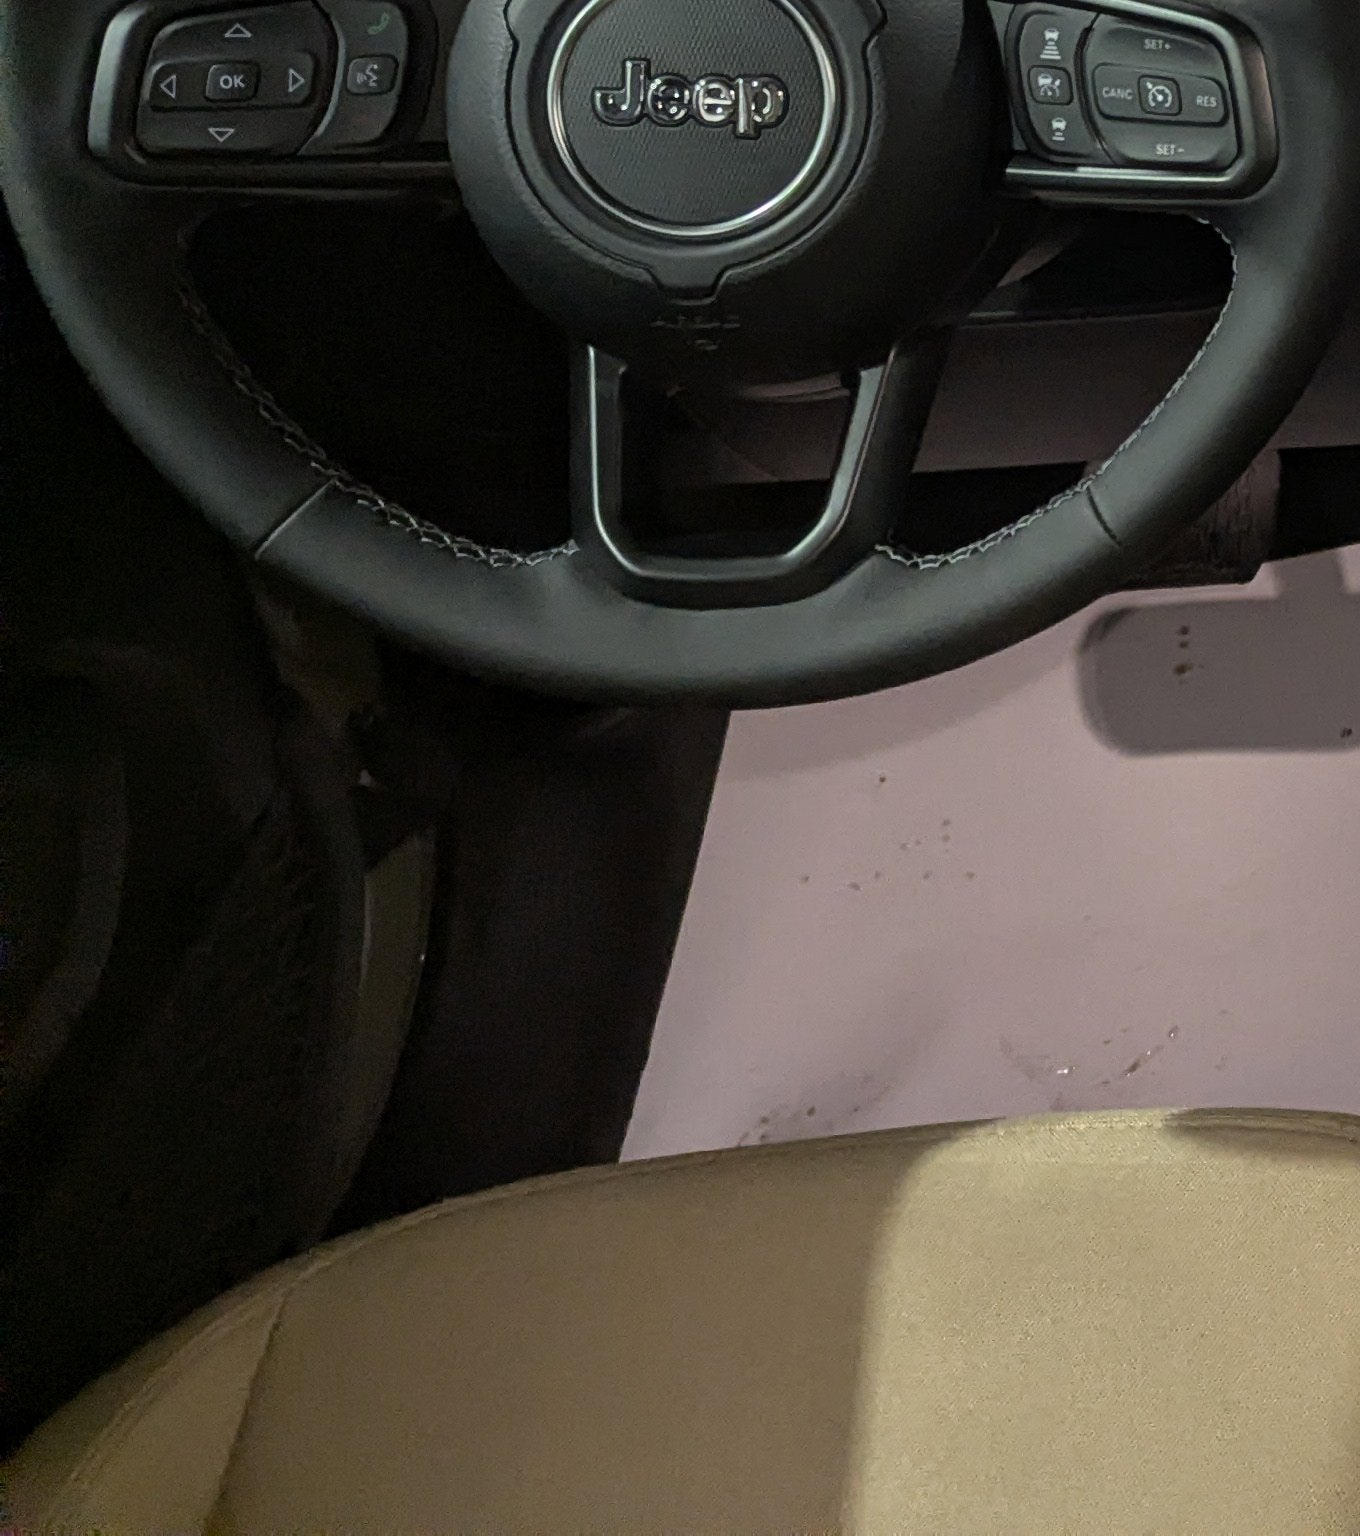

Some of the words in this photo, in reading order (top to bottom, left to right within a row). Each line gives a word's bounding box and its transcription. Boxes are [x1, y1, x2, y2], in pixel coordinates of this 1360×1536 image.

[1143, 38, 1172, 50] SET+
[220, 74, 245, 89] OK
[591, 56, 790, 141] Jeep
[1102, 87, 1133, 100] CANC
[1196, 95, 1217, 108] RES
